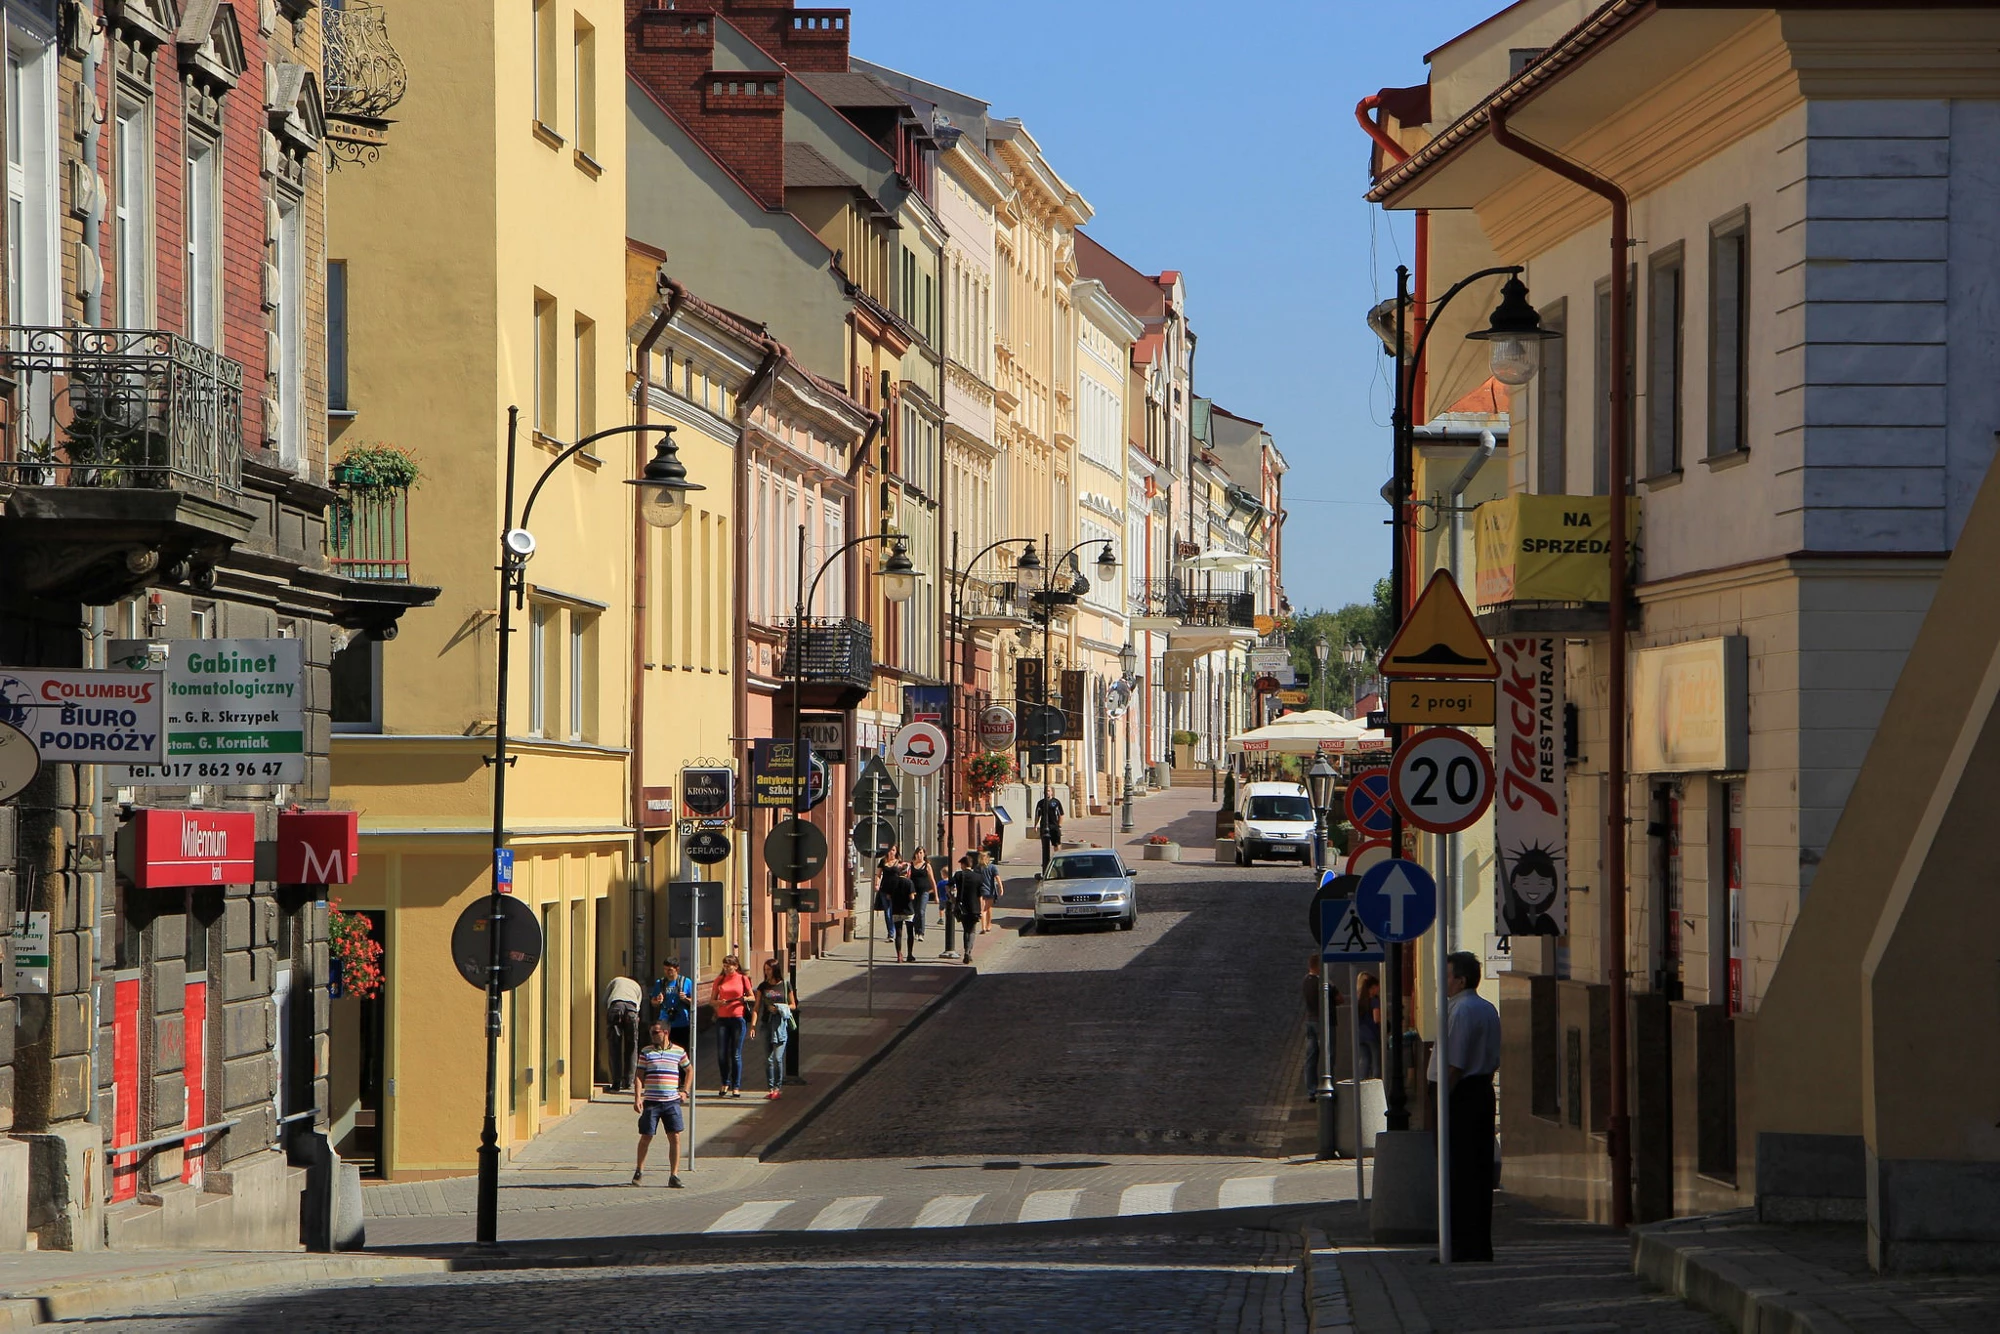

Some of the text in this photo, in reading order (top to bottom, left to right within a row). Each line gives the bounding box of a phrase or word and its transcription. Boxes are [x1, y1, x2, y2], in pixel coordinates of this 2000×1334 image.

[1563, 512, 1592, 527] NA
[187, 651, 276, 674] Gabinet
[168, 678, 294, 699] tomatologiczny
[1410, 694, 1472, 712] 2 progi
[60, 708, 137, 728] BIURO
[185, 711, 198, 723] G.
[202, 711, 214, 723] R.
[218, 710, 279, 725] Skrzypek
[982, 724, 1012, 733] TYSKIE
[40, 728, 156, 751] PODRÓŻY
[198, 737, 212, 749] G.
[216, 735, 269, 749] Korniak
[902, 756, 931, 767] ITAKA
[161, 763, 192, 777] 017
[198, 763, 230, 777] 862
[235, 762, 256, 776] 96
[262, 762, 283, 776] 47
[1410, 756, 1478, 806] 20
[687, 787, 718, 796] KROSNO
[181, 812, 227, 857] Millennium
[682, 824, 691, 833] 12
[686, 847, 726, 855] GERLACH
[211, 864, 222, 880] bank
[1497, 934, 1511, 955] 4
